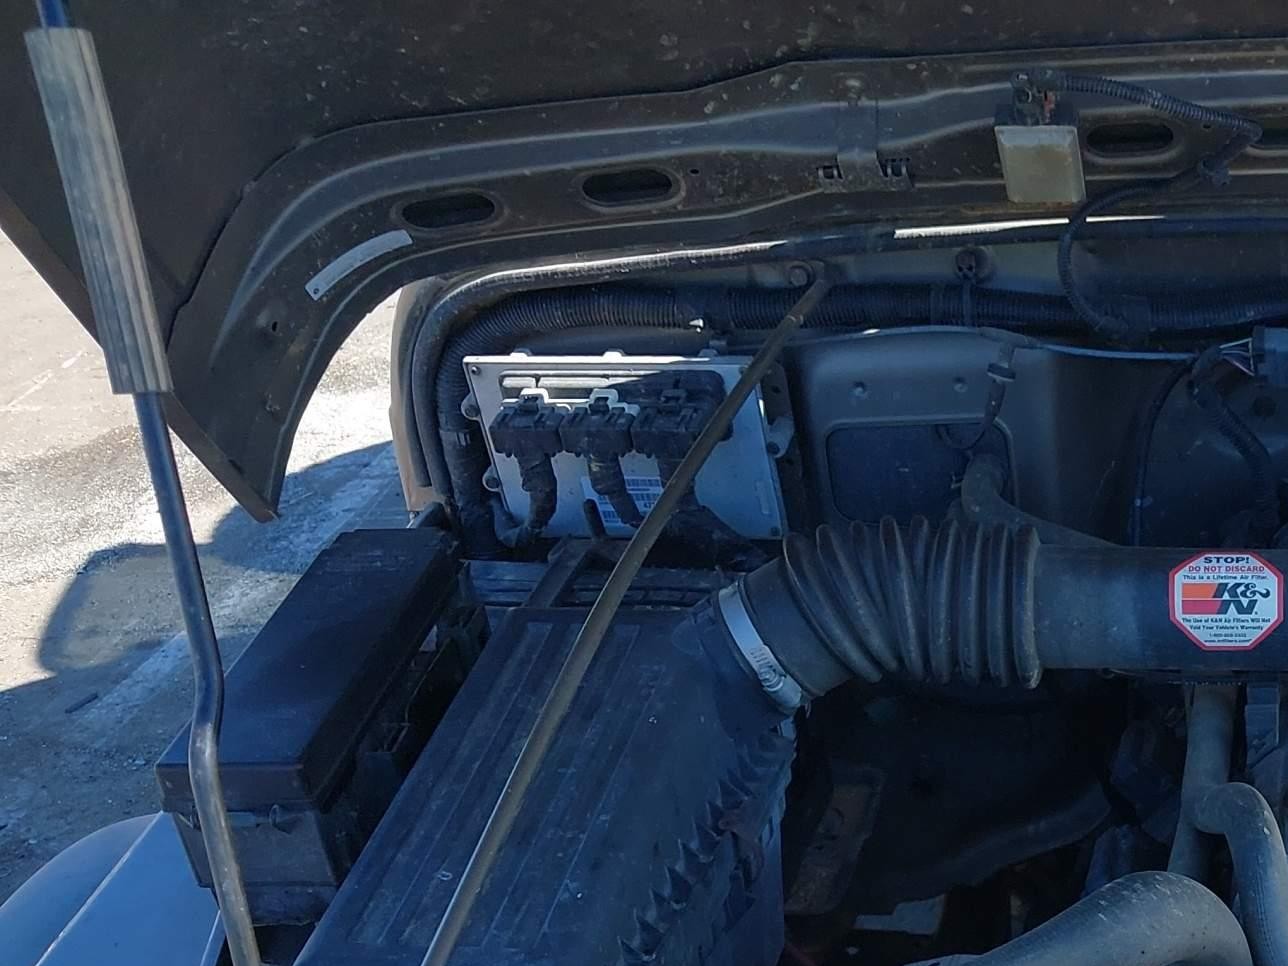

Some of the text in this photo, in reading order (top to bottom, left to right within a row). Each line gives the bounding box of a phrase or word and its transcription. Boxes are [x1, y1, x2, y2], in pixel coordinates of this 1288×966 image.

[1203, 556, 1250, 564] STOP!
[1188, 565, 1265, 573] DO NOT DISCARD
